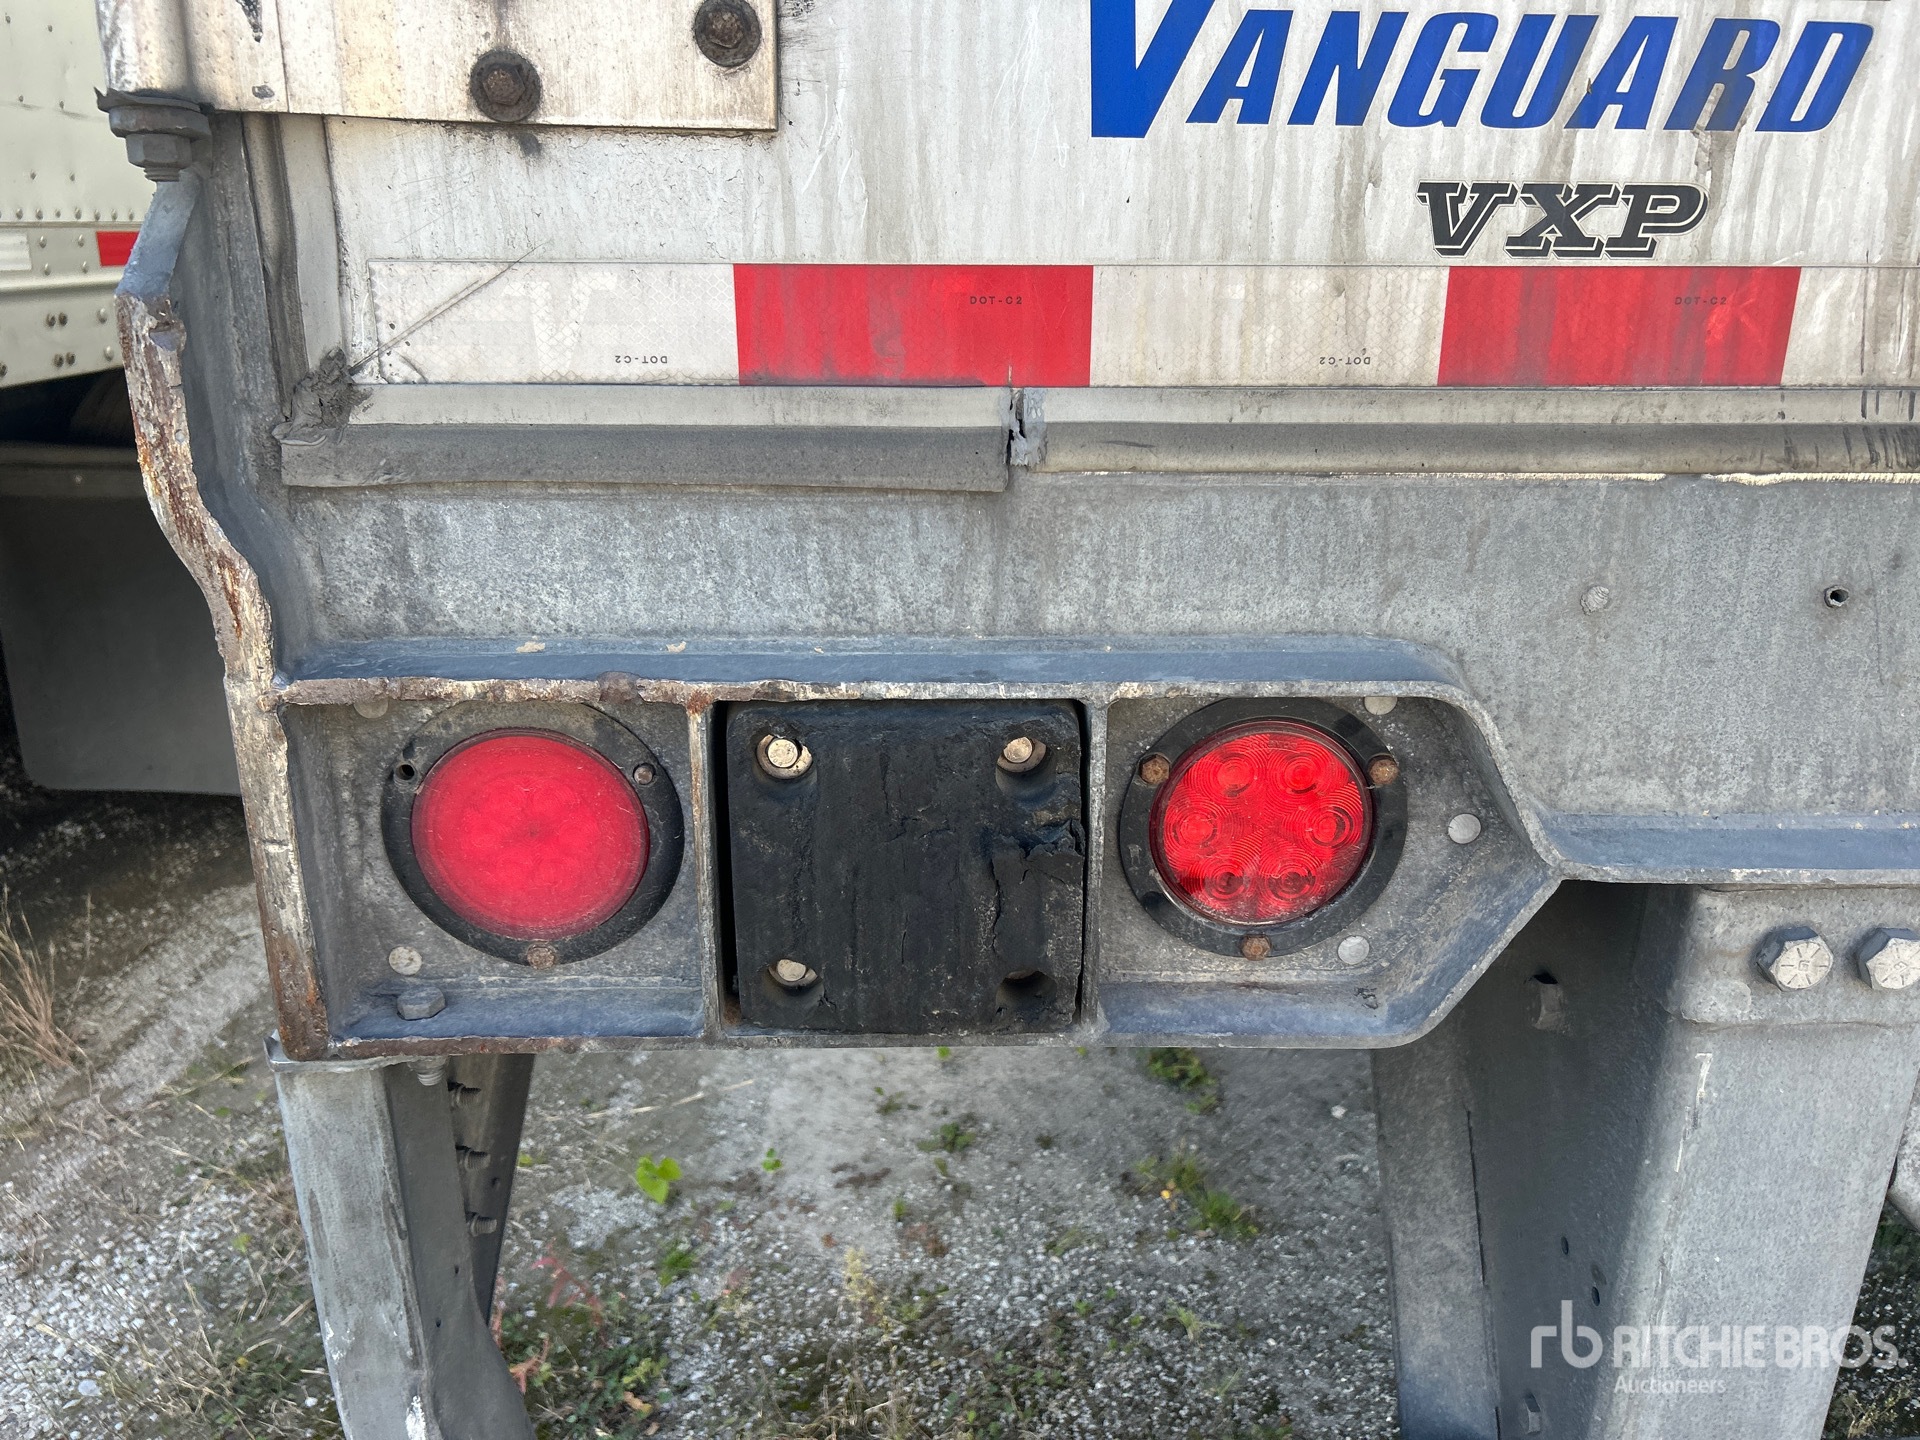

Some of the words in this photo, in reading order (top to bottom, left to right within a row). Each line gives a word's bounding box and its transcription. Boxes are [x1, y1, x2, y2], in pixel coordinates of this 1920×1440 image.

[1090, 0, 1874, 138] VANGUARD
[1417, 180, 1708, 258] VXP
[969, 295, 1023, 305] DOT-C2
[1674, 296, 1728, 305] DOT-C2
[614, 355, 668, 364] DOT-C2
[1319, 356, 1371, 365] DOT-C2
